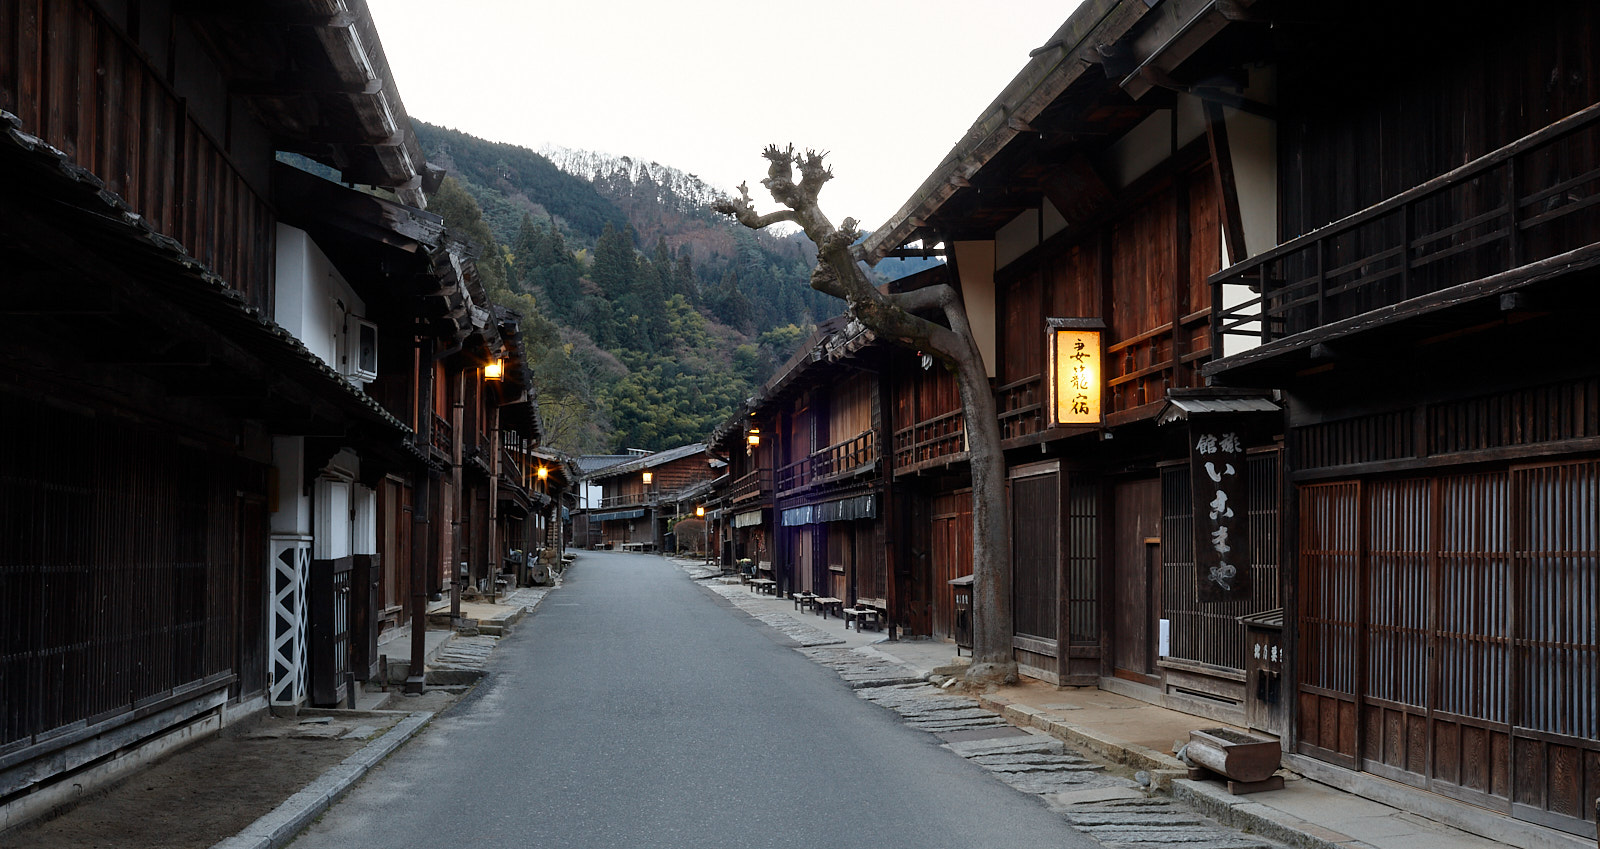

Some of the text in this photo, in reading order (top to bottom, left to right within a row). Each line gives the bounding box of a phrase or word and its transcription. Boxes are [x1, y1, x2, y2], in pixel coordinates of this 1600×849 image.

[1069, 338, 1091, 415] 妻籠宿
[1196, 433, 1242, 455] 旅館
